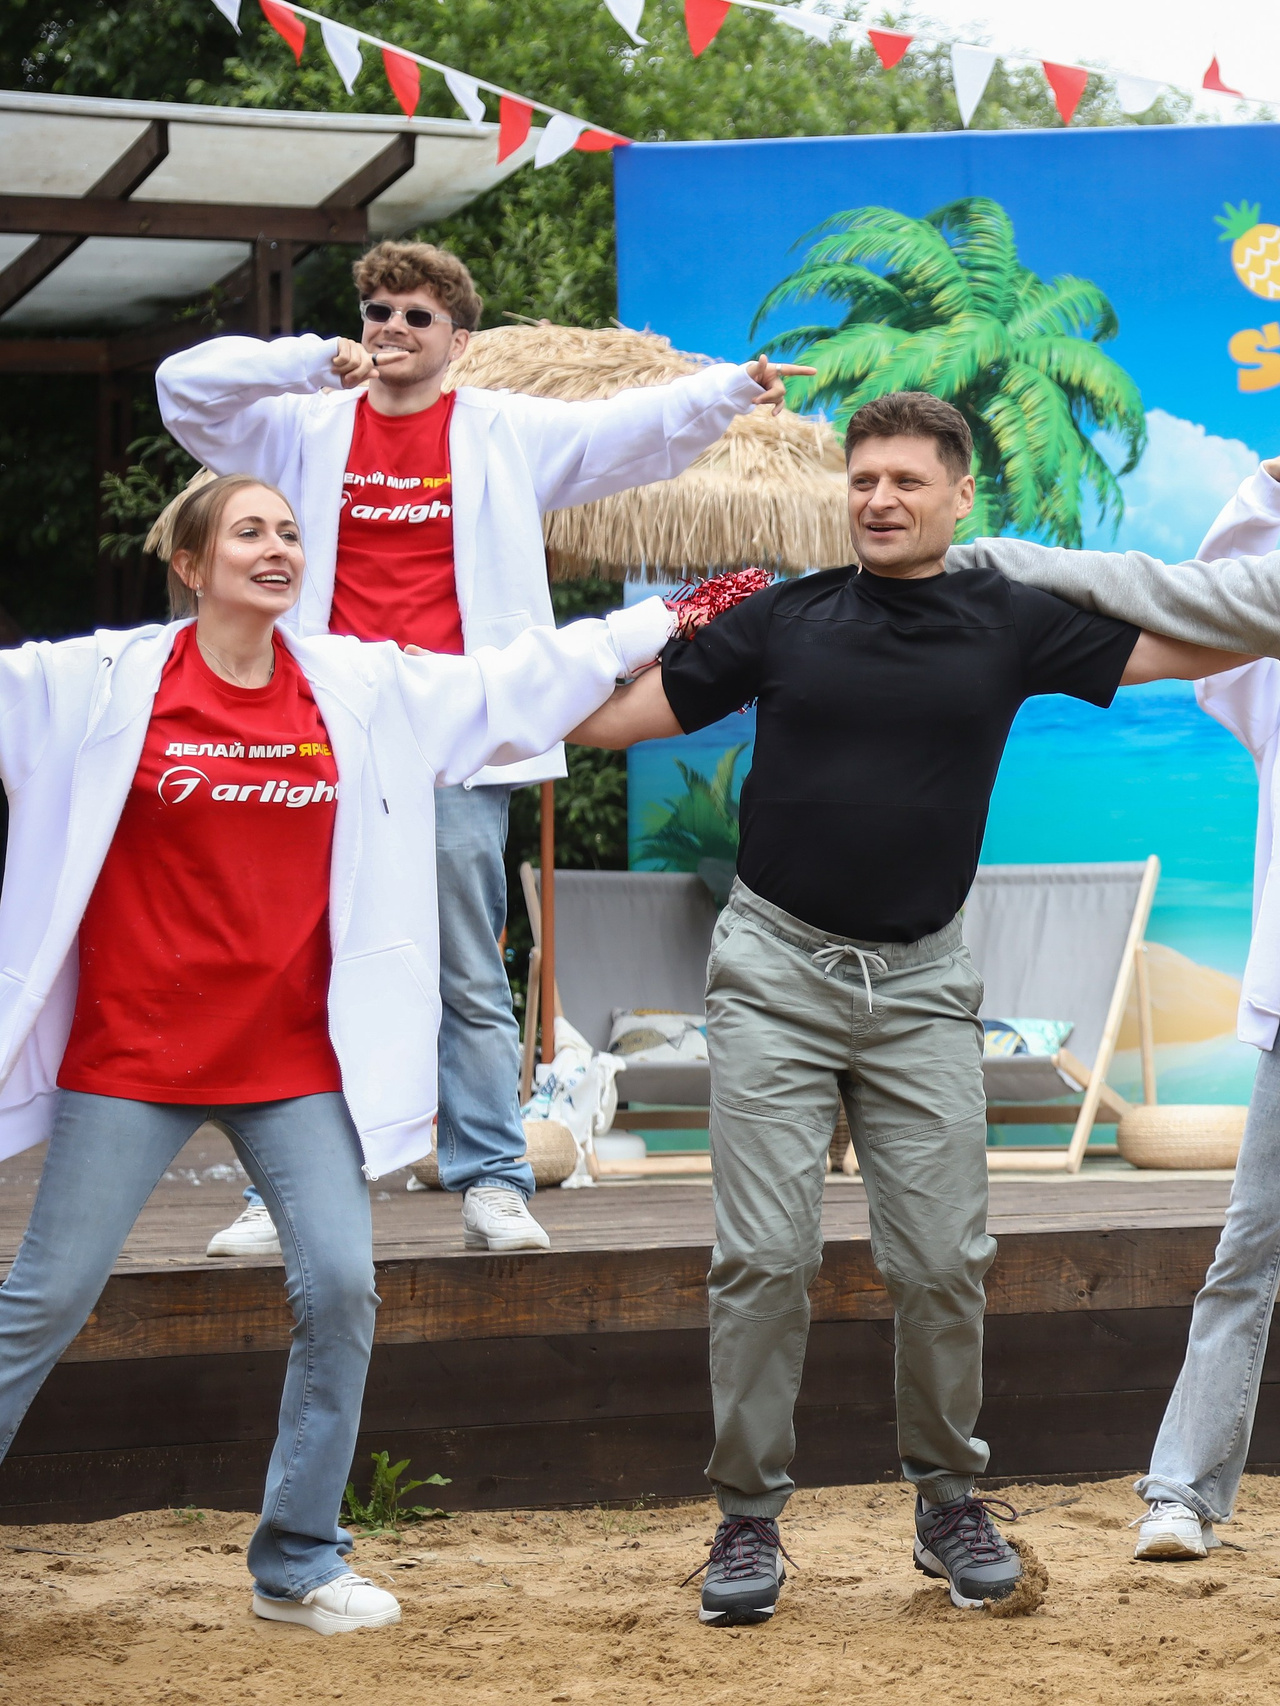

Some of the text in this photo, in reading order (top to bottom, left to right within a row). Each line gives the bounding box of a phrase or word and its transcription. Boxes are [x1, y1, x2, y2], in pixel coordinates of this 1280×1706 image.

[386, 475, 421, 489] МИР
[350, 500, 452, 523] arligh
[165, 741, 245, 758] ДЕЛАЙ
[248, 744, 296, 758] МИР
